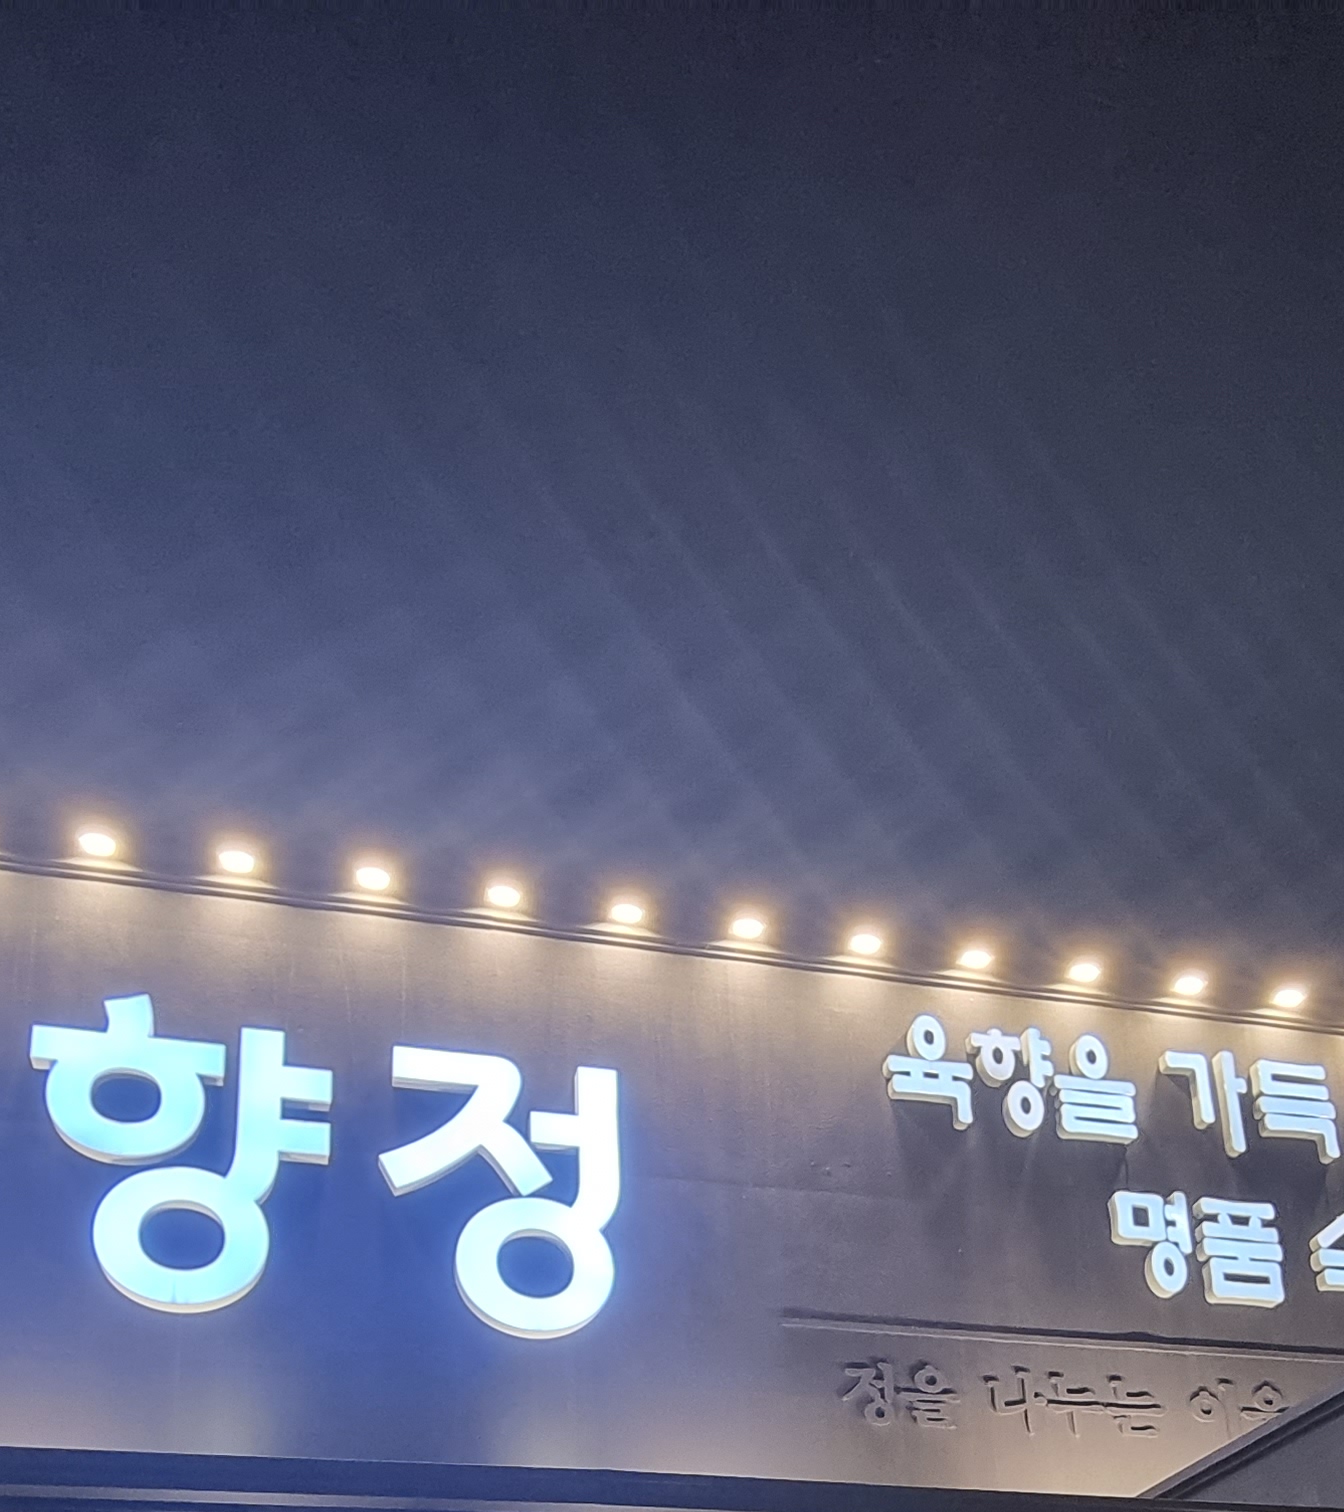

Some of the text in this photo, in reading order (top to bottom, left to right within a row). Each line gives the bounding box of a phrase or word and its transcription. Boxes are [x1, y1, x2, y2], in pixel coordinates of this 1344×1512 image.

[882, 1014, 1139, 1145] 육향을
[1159, 1050, 1341, 1164] 가득
[1108, 1191, 1285, 1308] 명품
[841, 1358, 960, 1431] 정을
[982, 1366, 1166, 1438] 나누는
